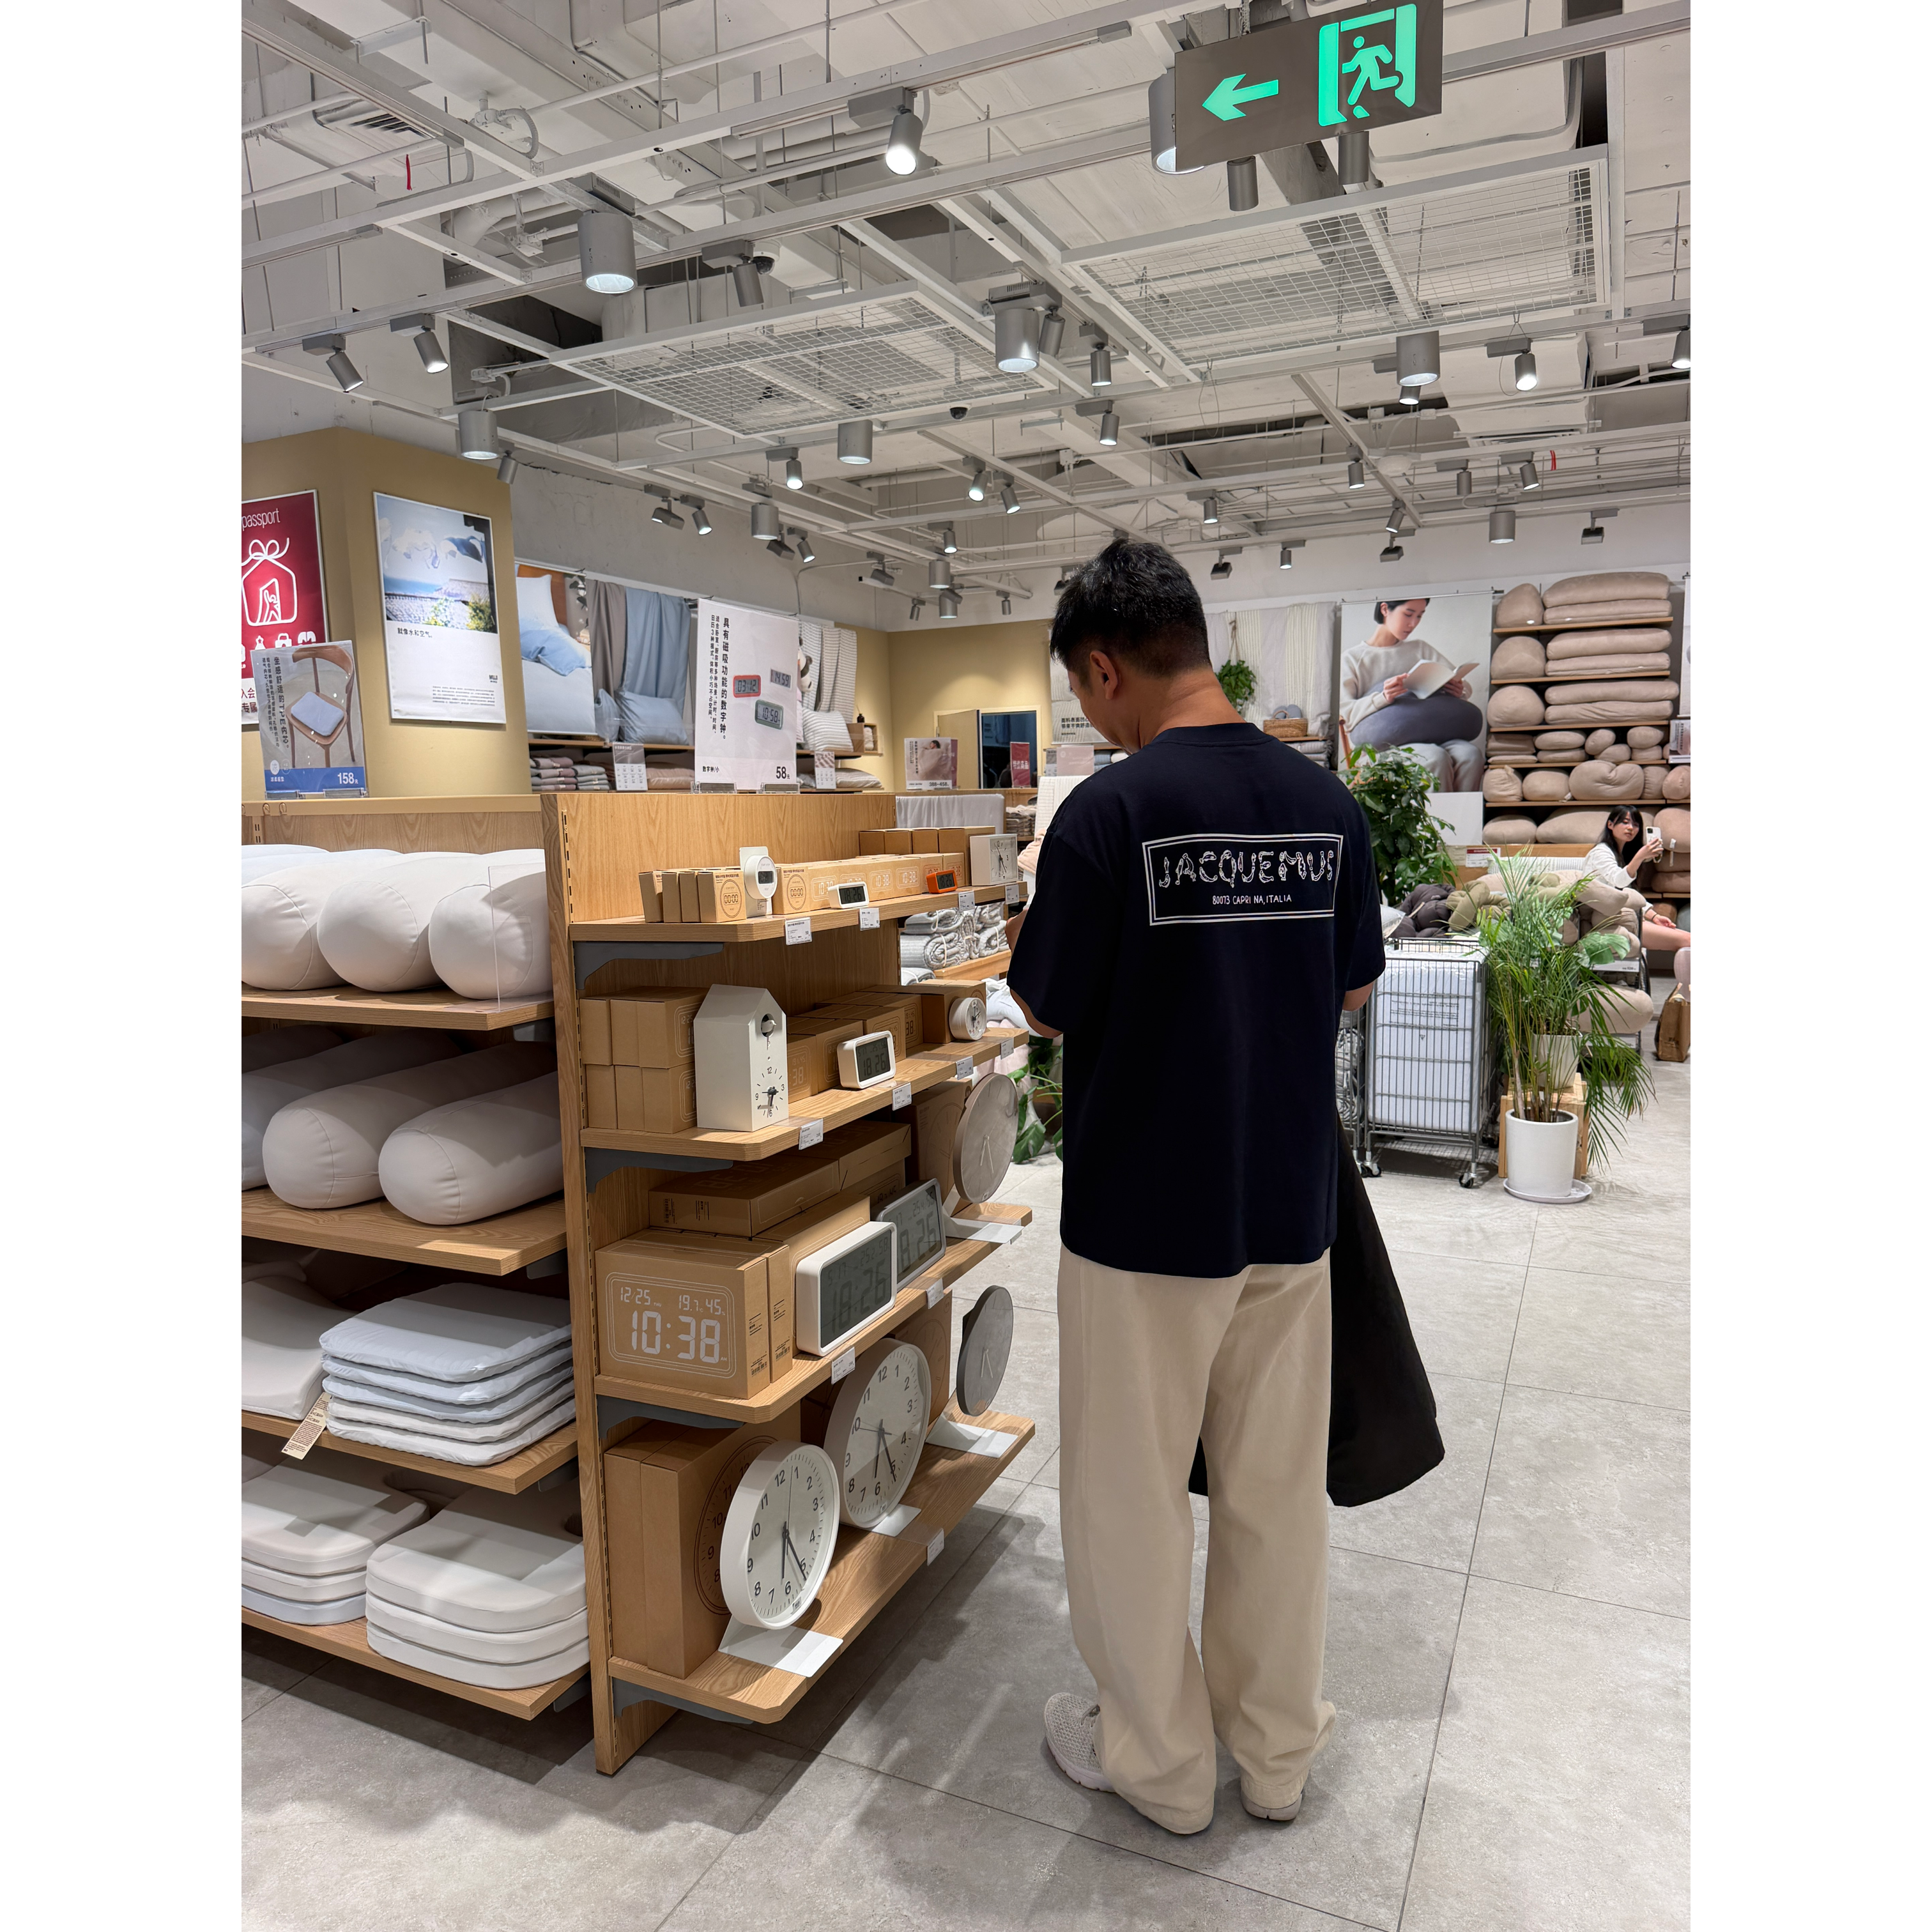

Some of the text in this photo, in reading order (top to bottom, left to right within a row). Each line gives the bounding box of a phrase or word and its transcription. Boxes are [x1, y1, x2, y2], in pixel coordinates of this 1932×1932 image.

[241, 508, 280, 531] passport
[720, 617, 730, 739] 具有磁吸功能的数字钟。
[762, 707, 778, 723] 10:58
[1159, 851, 1334, 889] JACQUEMUS
[1212, 895, 1230, 905] 80073
[1232, 895, 1252, 905] CAPRI
[755, 1092, 759, 1101] 9
[769, 1109, 773, 1117] 6
[900, 1211, 937, 1273] 8:26
[620, 1287, 651, 1305] 12/25
[631, 1310, 721, 1364] 10:38
[877, 1365, 887, 1383] 12
[895, 1365, 899, 1377] 1
[904, 1376, 910, 1392] 2
[907, 1399, 913, 1413] 3
[852, 1416, 861, 1435] 10
[901, 1431, 907, 1445] 4
[774, 1469, 786, 1487] 12
[794, 1466, 799, 1479] 1
[806, 1476, 813, 1491] 2
[848, 1478, 855, 1494] 8
[875, 1481, 880, 1496] 6
[861, 1486, 866, 1503] 7
[813, 1497, 818, 1512] 3
[712, 1512, 723, 1529] 10
[751, 1522, 760, 1540] 10
[809, 1529, 815, 1543] 4
[708, 1545, 714, 1560] 9
[747, 1558, 753, 1573] 9
[755, 1581, 761, 1597] 8
[785, 1581, 792, 1595] 6
[769, 1588, 775, 1605] 7
